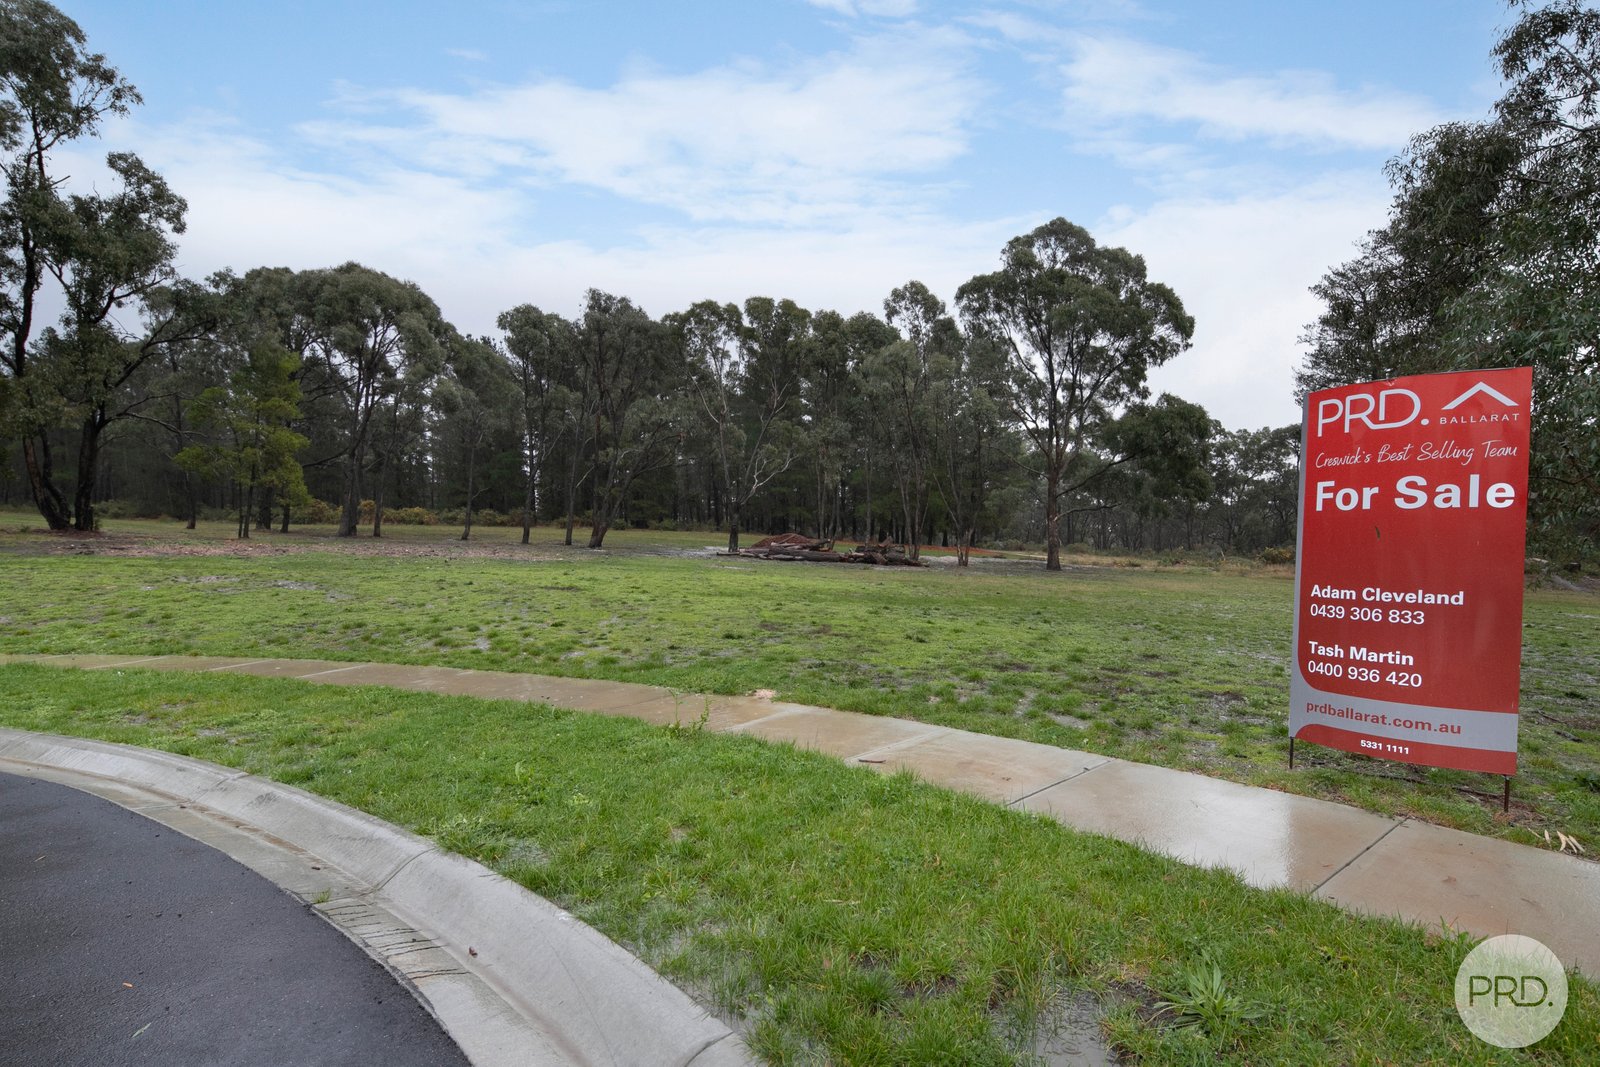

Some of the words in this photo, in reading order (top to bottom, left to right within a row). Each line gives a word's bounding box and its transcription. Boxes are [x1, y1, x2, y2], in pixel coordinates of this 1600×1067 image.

[1439, 413, 1520, 425] BALLARAT
[1315, 446, 1372, 469] Creswick's
[1377, 443, 1415, 463] Best
[1417, 440, 1475, 466] Selling
[1481, 439, 1518, 459] Team
[1315, 480, 1380, 512] For
[1394, 473, 1516, 510] Sale
[1310, 584, 1357, 601] Adam
[1361, 587, 1465, 606] Cleveland
[1310, 603, 1346, 619] 0439
[1349, 606, 1383, 622] 306
[1387, 609, 1426, 625] 833
[1308, 640, 1345, 659] Tash
[1349, 645, 1414, 666] Martin
[1307, 660, 1343, 678] 0400
[1347, 666, 1381, 683] 936
[1385, 671, 1423, 688] 420
[1306, 700, 1462, 735] prdballarat.com.au
[1360, 739, 1383, 751] 5331
[1386, 743, 1410, 755] 1111
